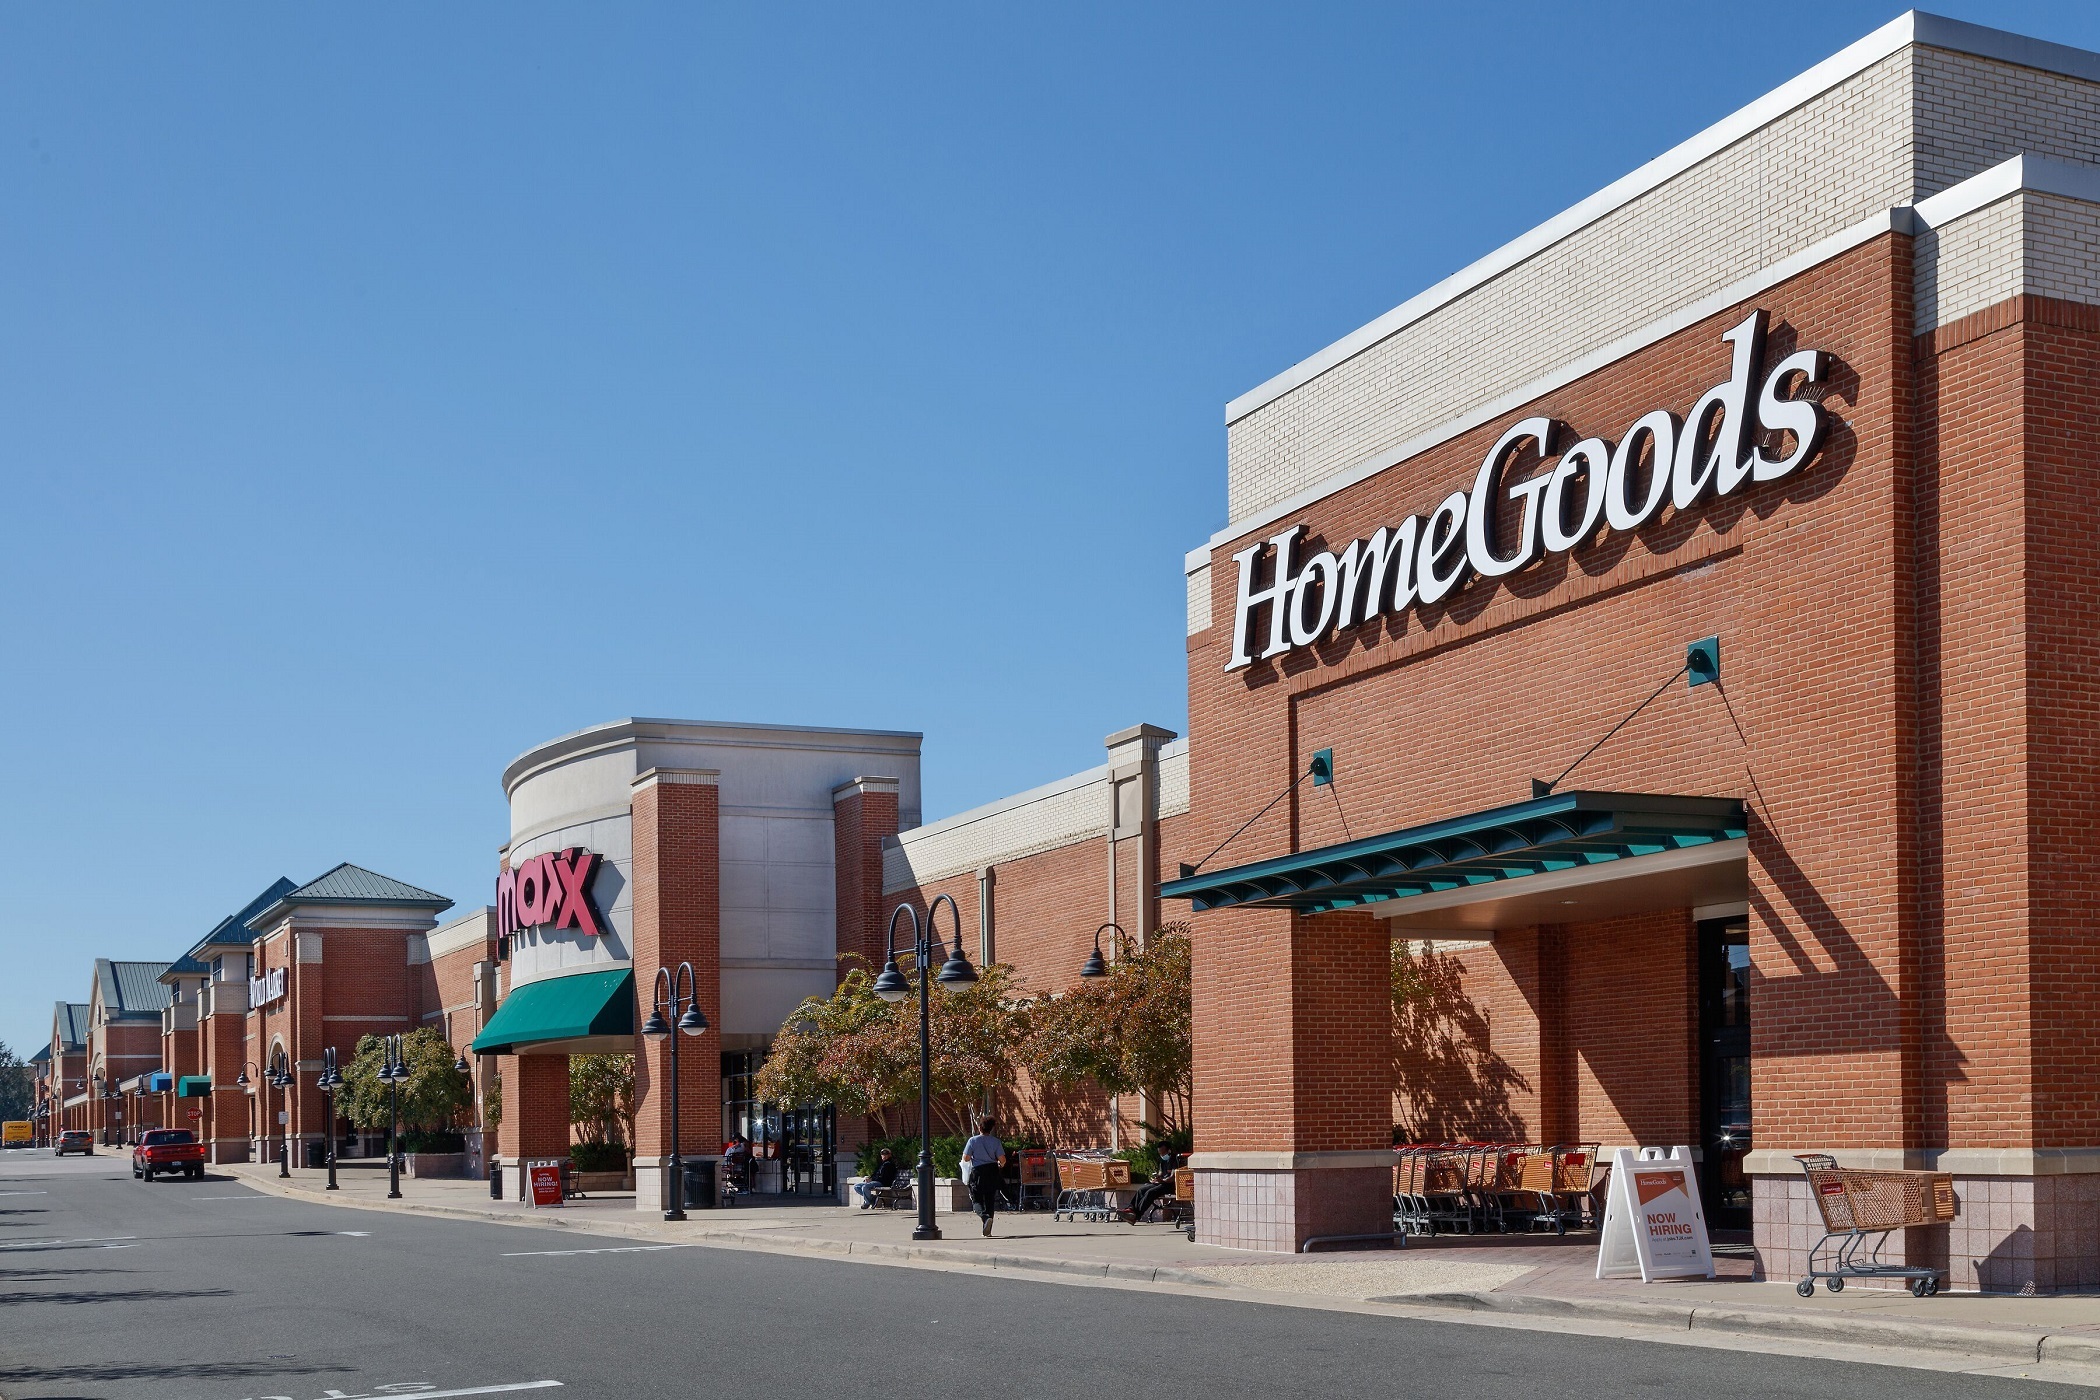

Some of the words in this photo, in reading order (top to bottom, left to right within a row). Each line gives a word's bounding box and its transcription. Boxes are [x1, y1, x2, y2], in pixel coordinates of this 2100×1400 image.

[1224, 308, 1828, 673] HomeGoods
[1647, 1212, 1676, 1224] NOW
[1649, 1223, 1692, 1236] HIRING
